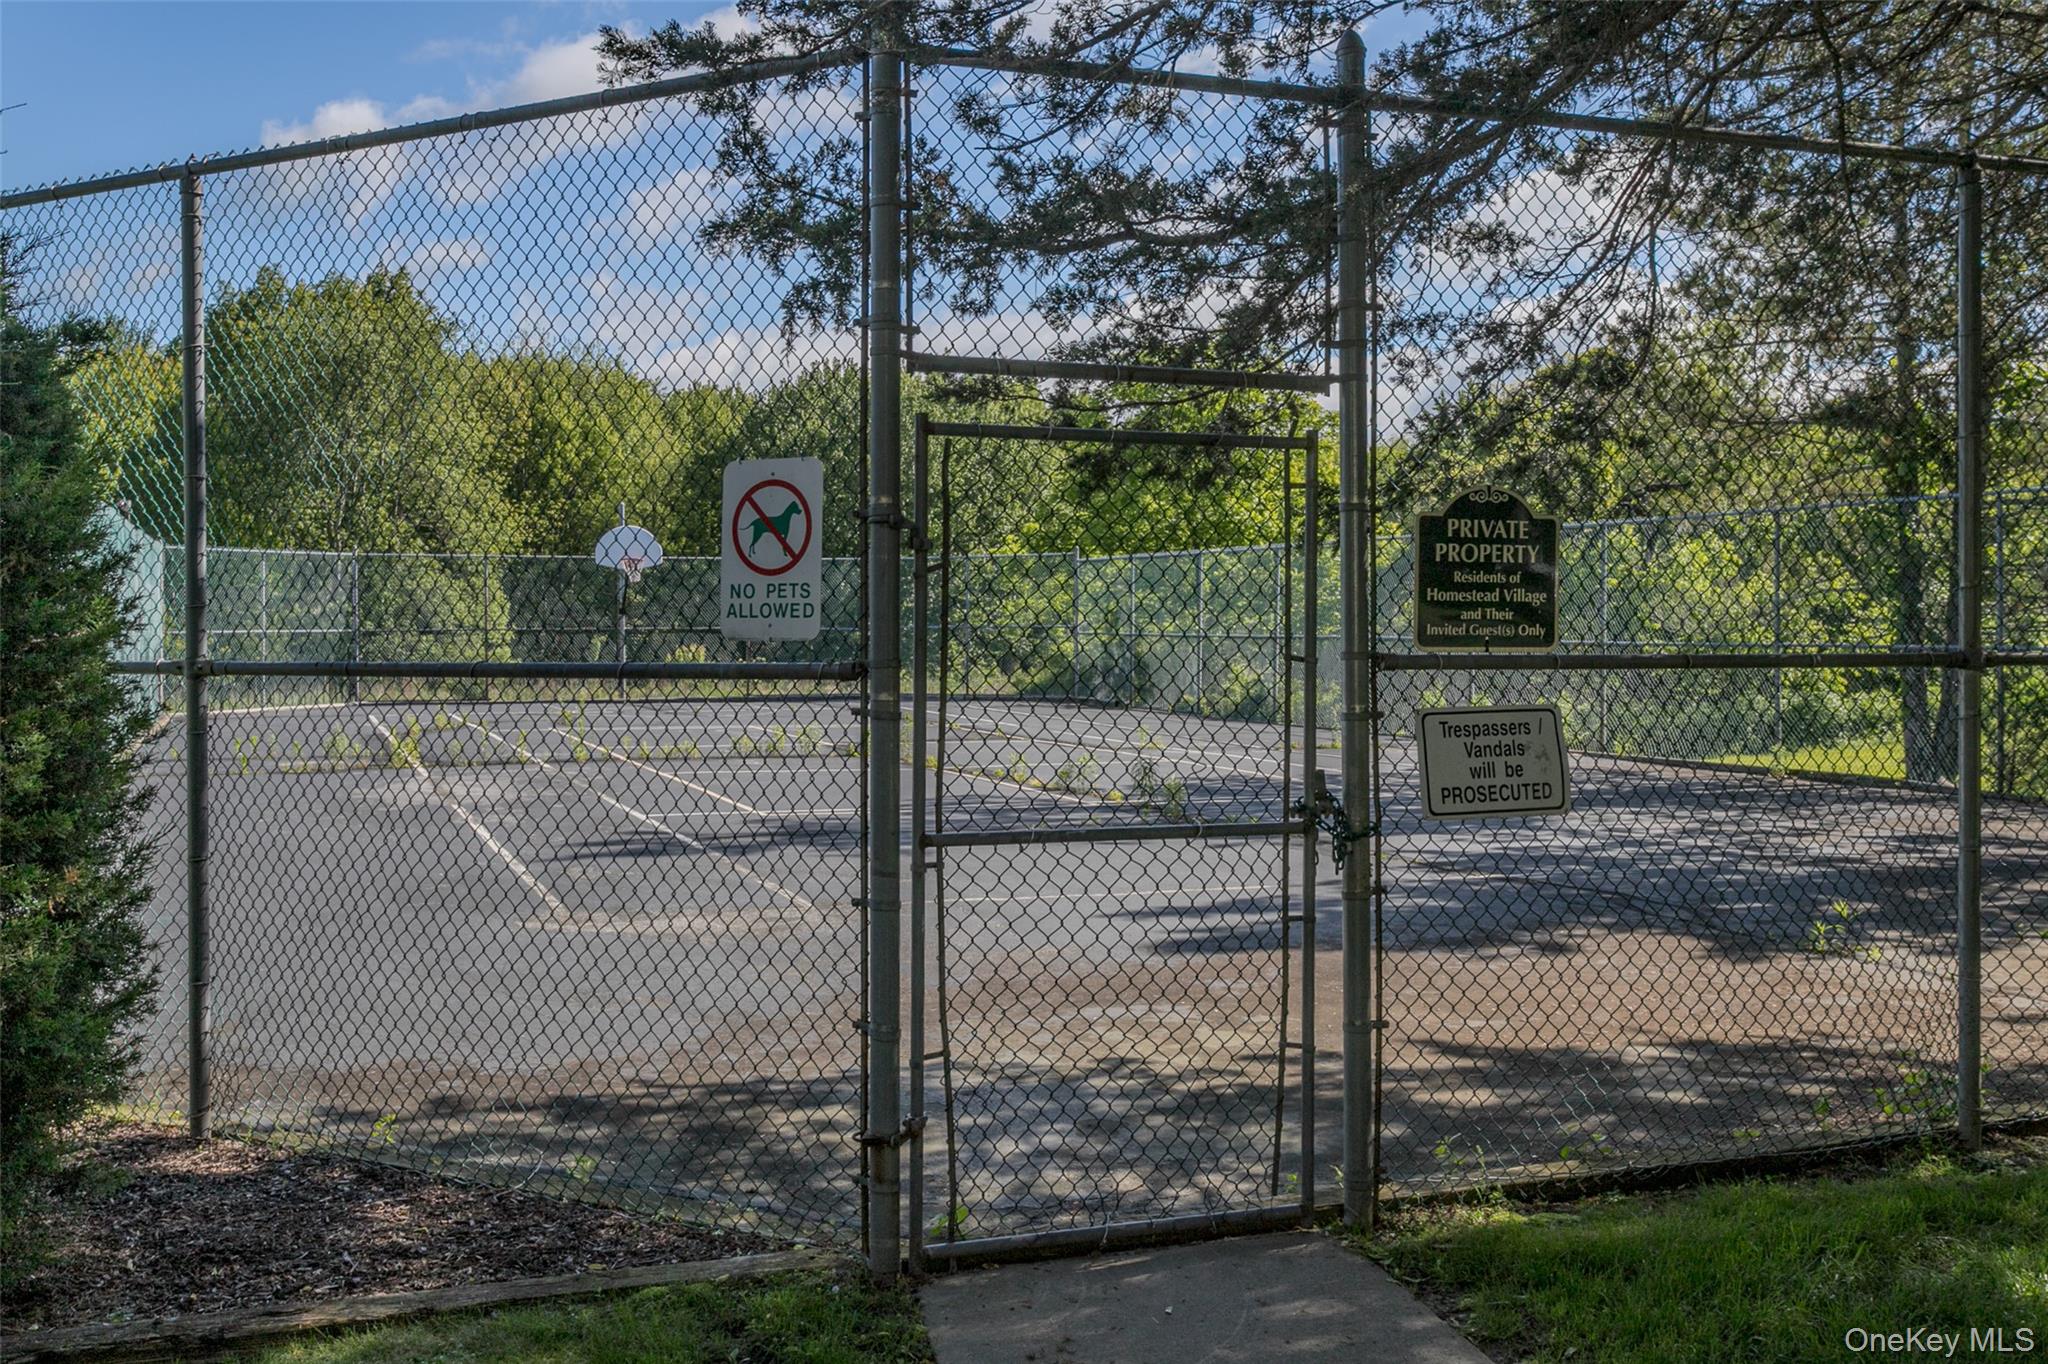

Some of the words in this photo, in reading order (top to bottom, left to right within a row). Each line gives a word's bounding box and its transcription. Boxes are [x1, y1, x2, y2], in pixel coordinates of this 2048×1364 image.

[1447, 518, 1529, 539] PRIVATE
[1435, 543, 1540, 564] PROPERTY
[1454, 570, 1507, 583] Residents
[1509, 571, 1522, 583] of
[730, 583, 756, 599] NO
[766, 582, 811, 599] PETS
[1427, 588, 1500, 602] Homestead
[1504, 588, 1547, 606] Village
[726, 602, 815, 619] ALLOWED
[1460, 608, 1482, 620] and
[1485, 608, 1514, 620] Their
[1426, 623, 1466, 636] Invited
[1469, 624, 1515, 637] Guest(s)
[1518, 624, 1546, 639] Only
[1438, 720, 1531, 740] Trespassers
[1463, 739, 1525, 758] Vandals
[1469, 761, 1496, 779] will
[1504, 761, 1524, 778] be
[1441, 782, 1553, 805] PROSECUTED
